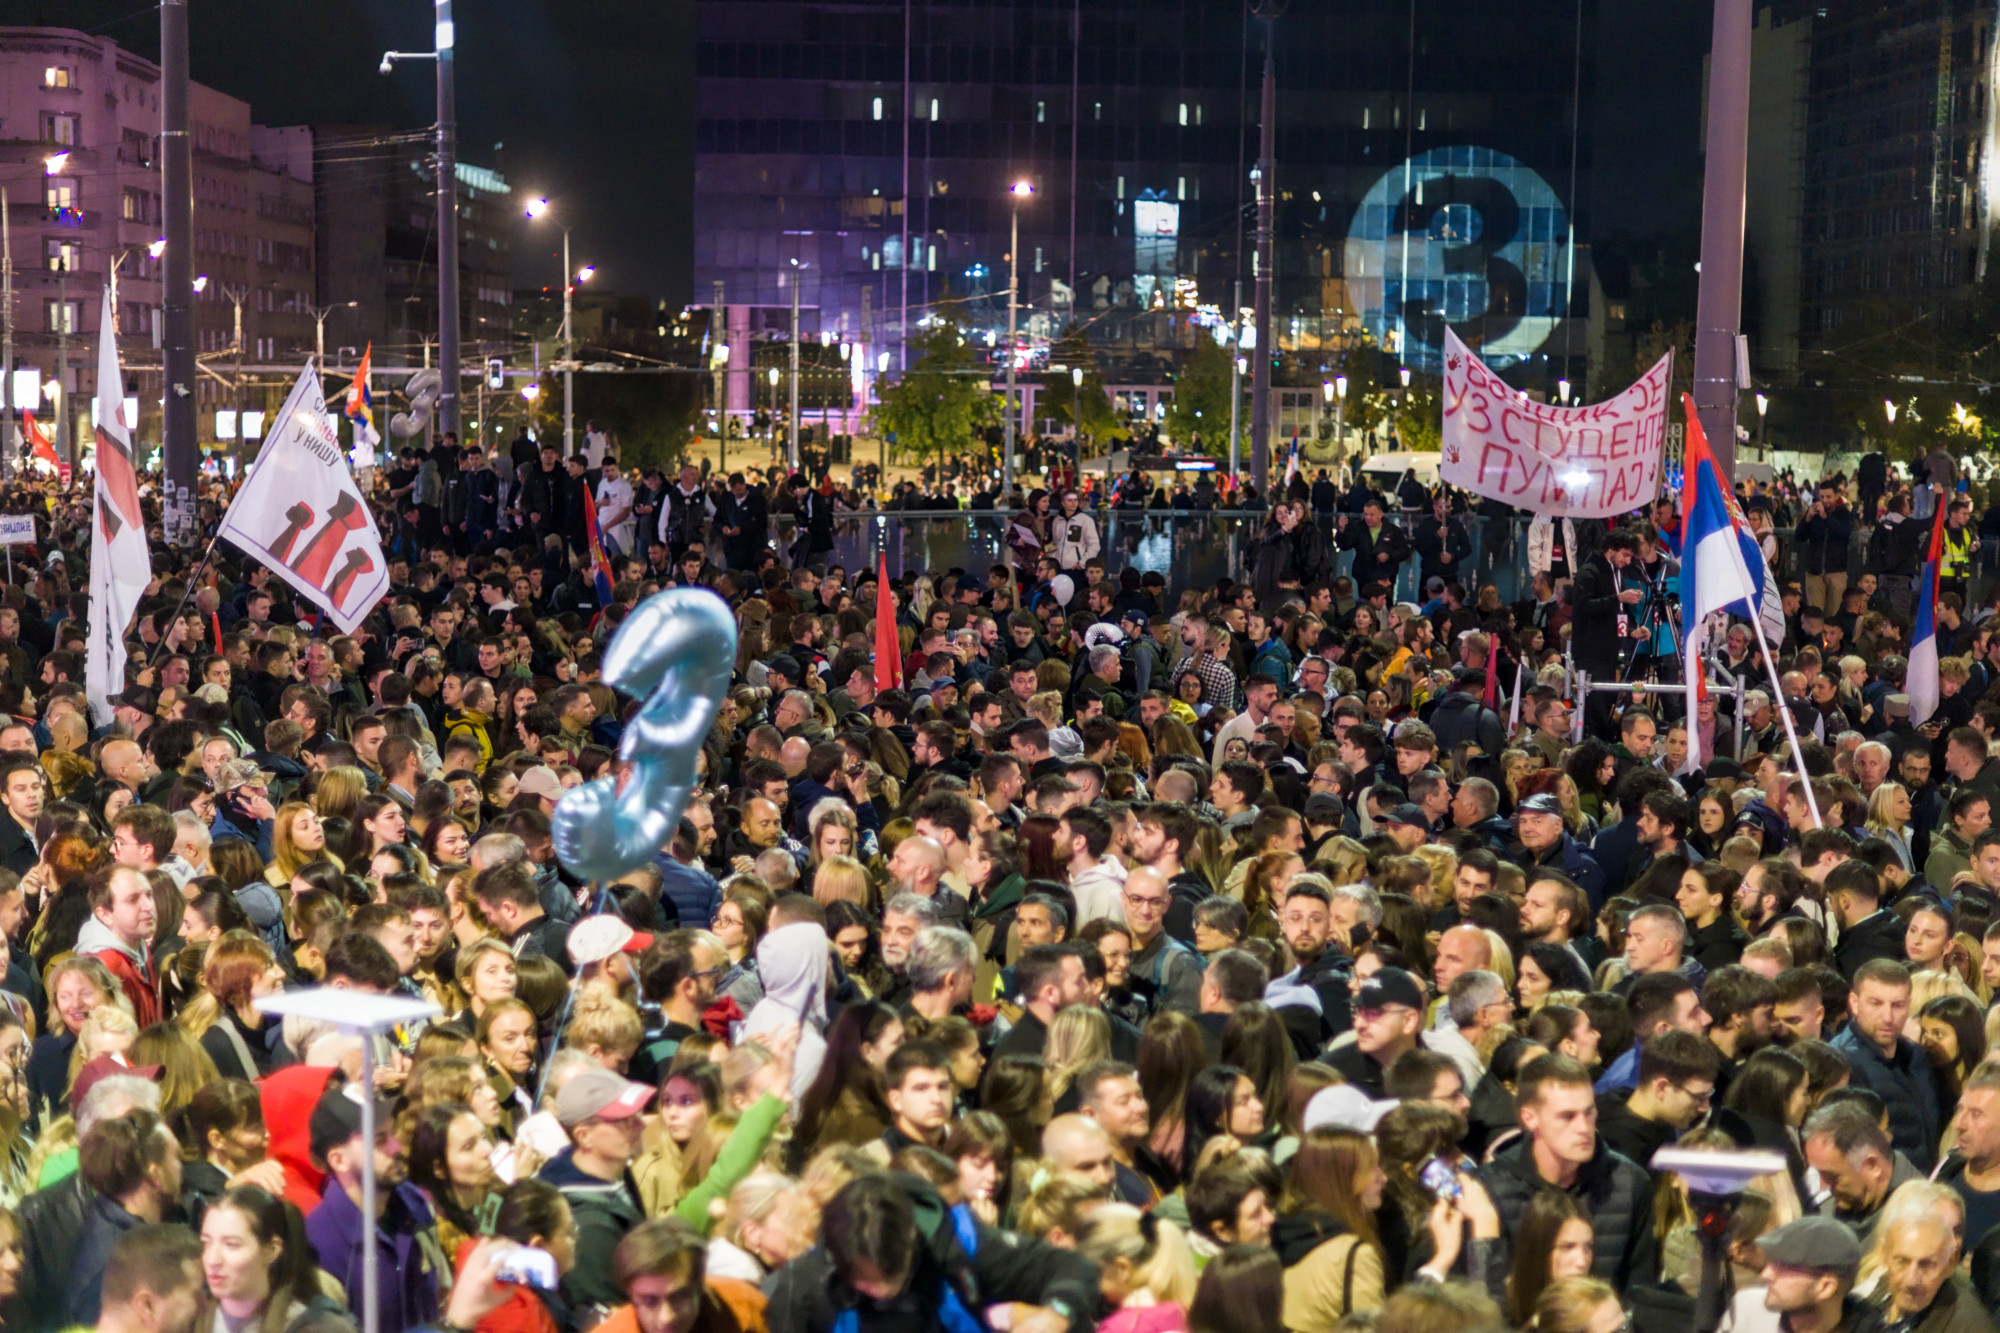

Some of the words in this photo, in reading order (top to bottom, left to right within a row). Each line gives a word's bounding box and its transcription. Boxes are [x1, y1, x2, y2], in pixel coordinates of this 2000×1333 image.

[1393, 175, 1528, 349] 3
[1444, 375, 1492, 433] УЗ
[293, 427, 305, 443] У
[303, 434, 339, 467] НИШУ
